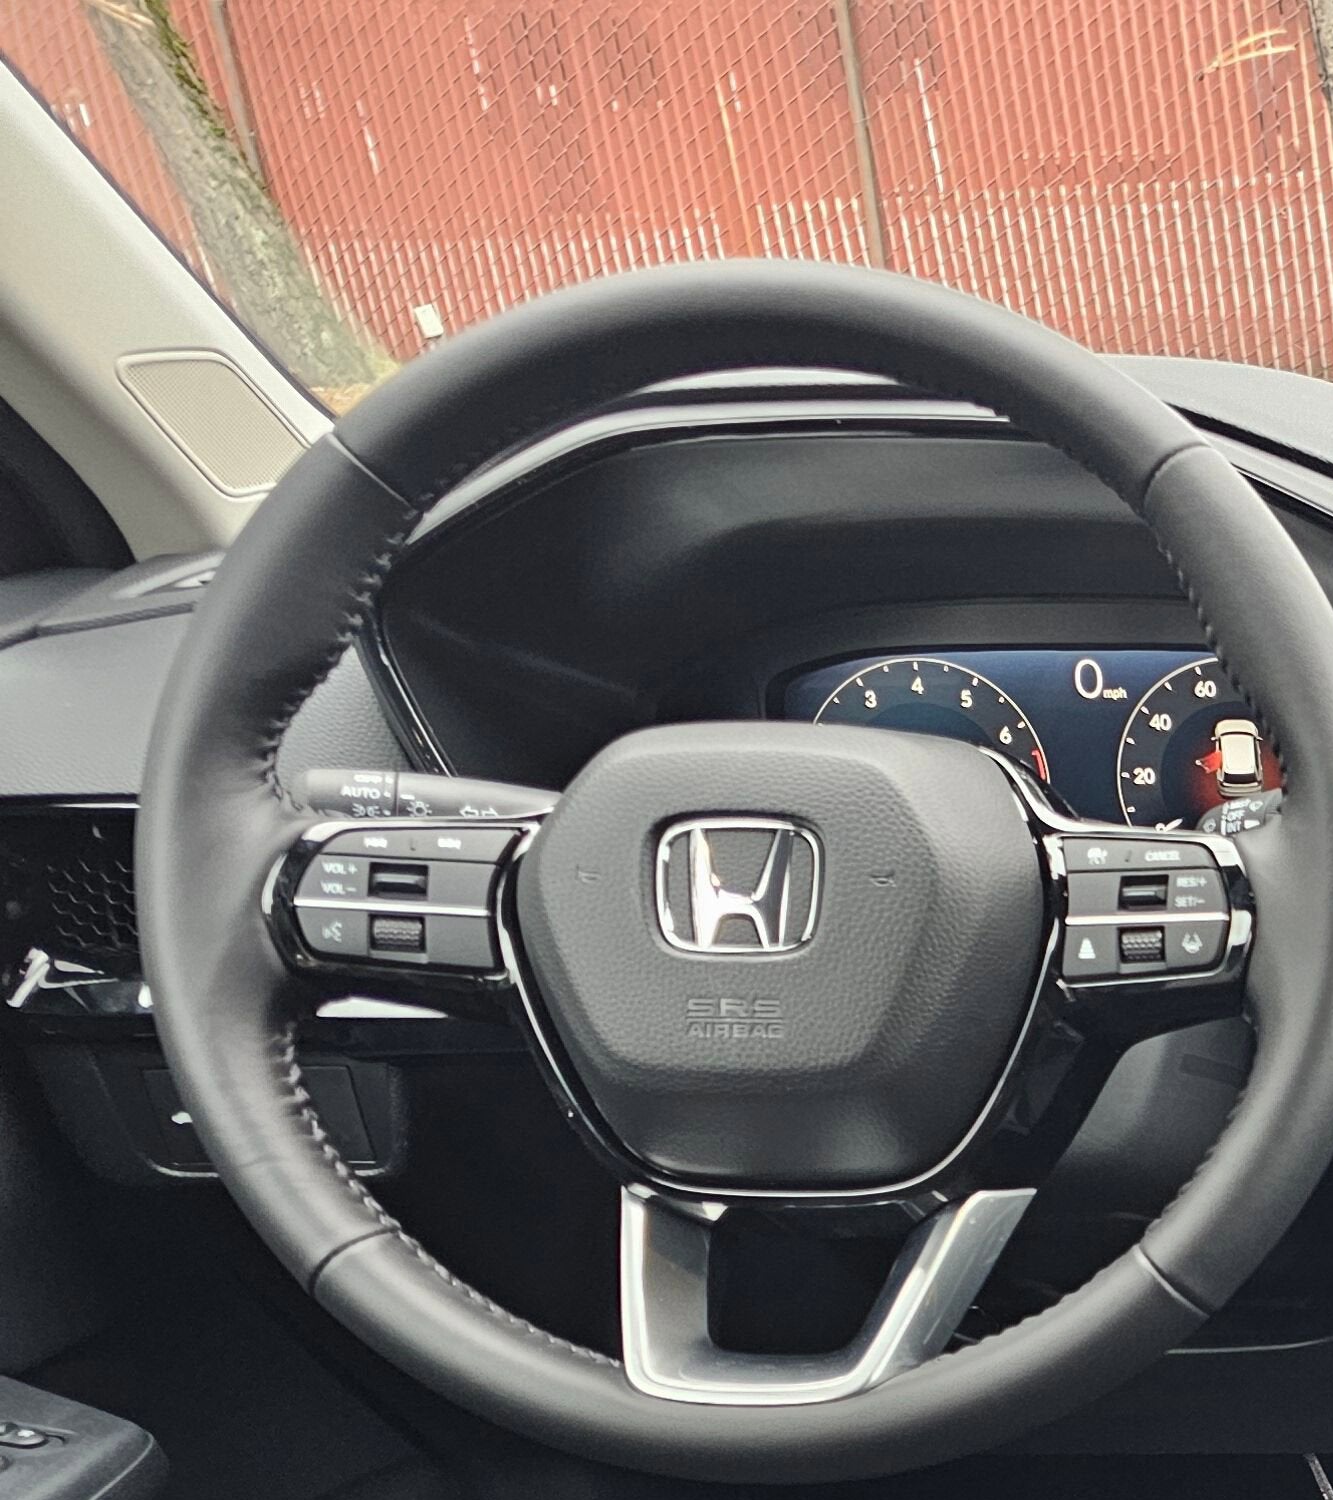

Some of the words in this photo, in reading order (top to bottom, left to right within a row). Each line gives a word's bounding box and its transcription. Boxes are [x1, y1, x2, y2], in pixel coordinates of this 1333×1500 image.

[911, 676, 925, 694] 4
[1075, 659, 1103, 699] 0
[1103, 687, 1127, 700] mph
[864, 689, 877, 708] 3
[960, 689, 973, 708] 5
[1194, 681, 1216, 698] 60
[1149, 713, 1172, 731] 40
[999, 725, 1013, 745] 6
[1133, 767, 1156, 785] 20
[341, 785, 381, 799] AUTO
[686, 998, 781, 1018] SRS
